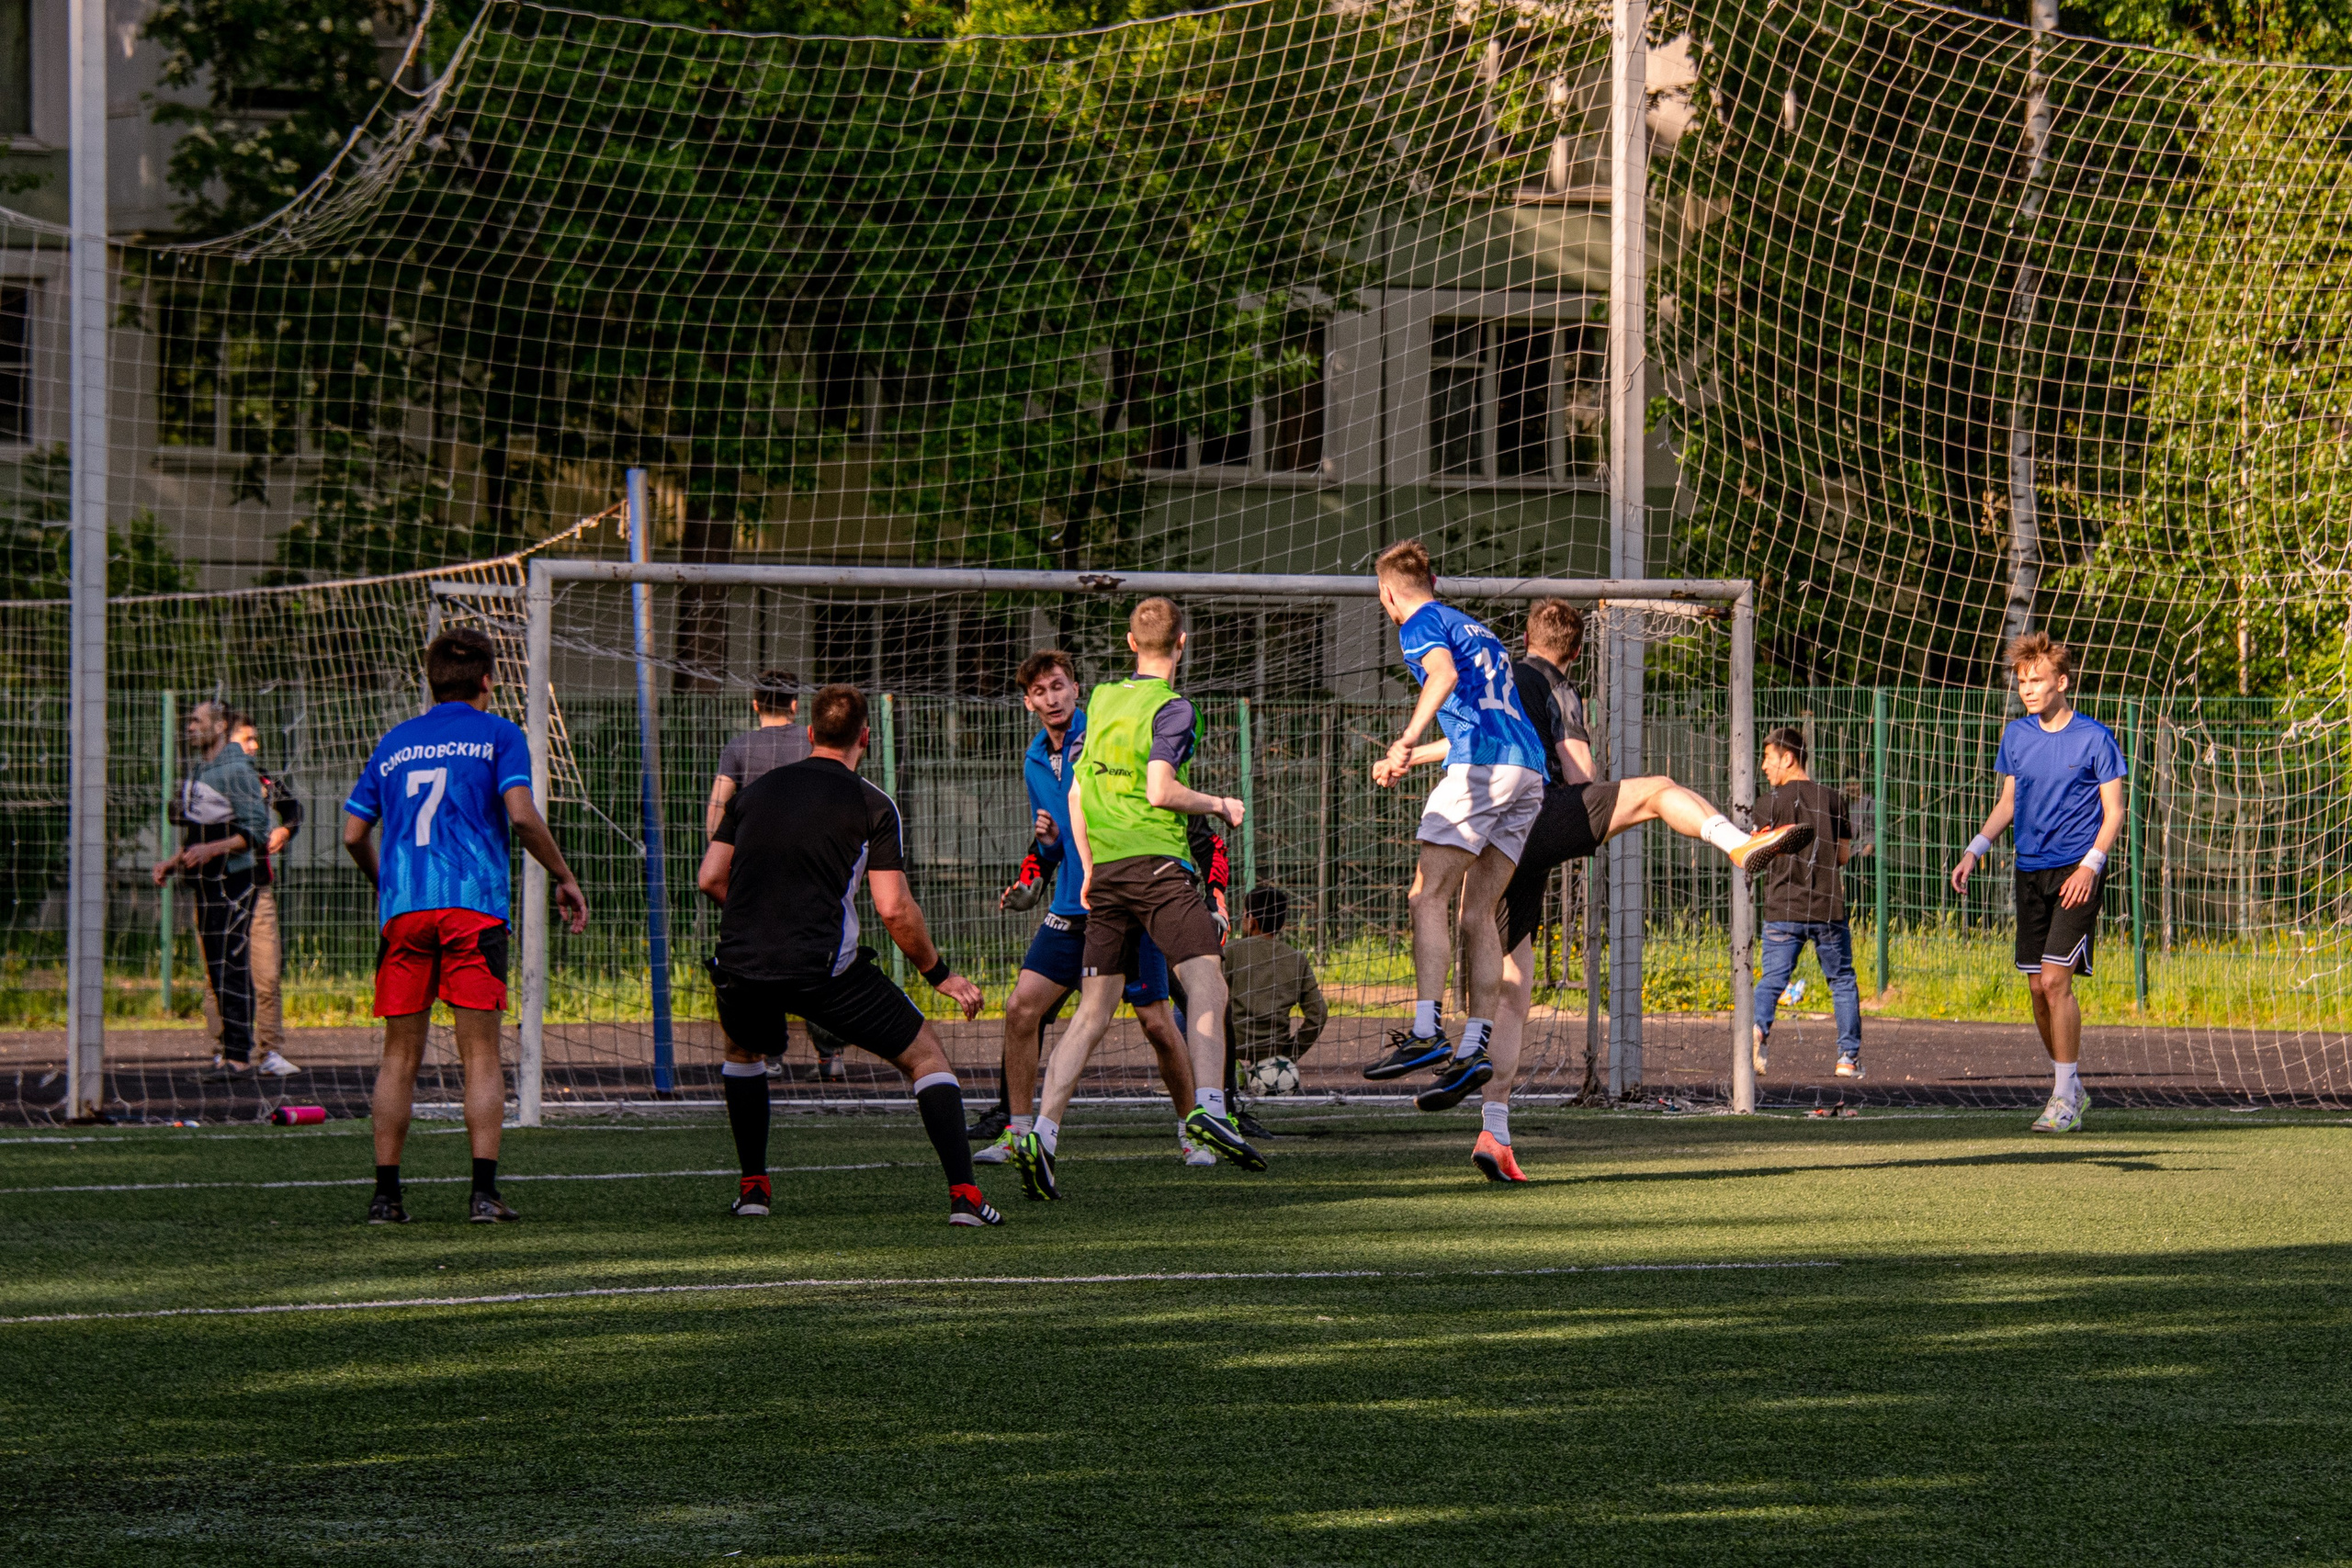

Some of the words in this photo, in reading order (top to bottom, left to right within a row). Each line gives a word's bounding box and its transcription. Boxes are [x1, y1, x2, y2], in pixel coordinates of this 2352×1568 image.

[1474, 647, 1521, 721] 12
[379, 741, 494, 777] СОКОЛОВСКИЙ
[406, 767, 447, 847] 7
